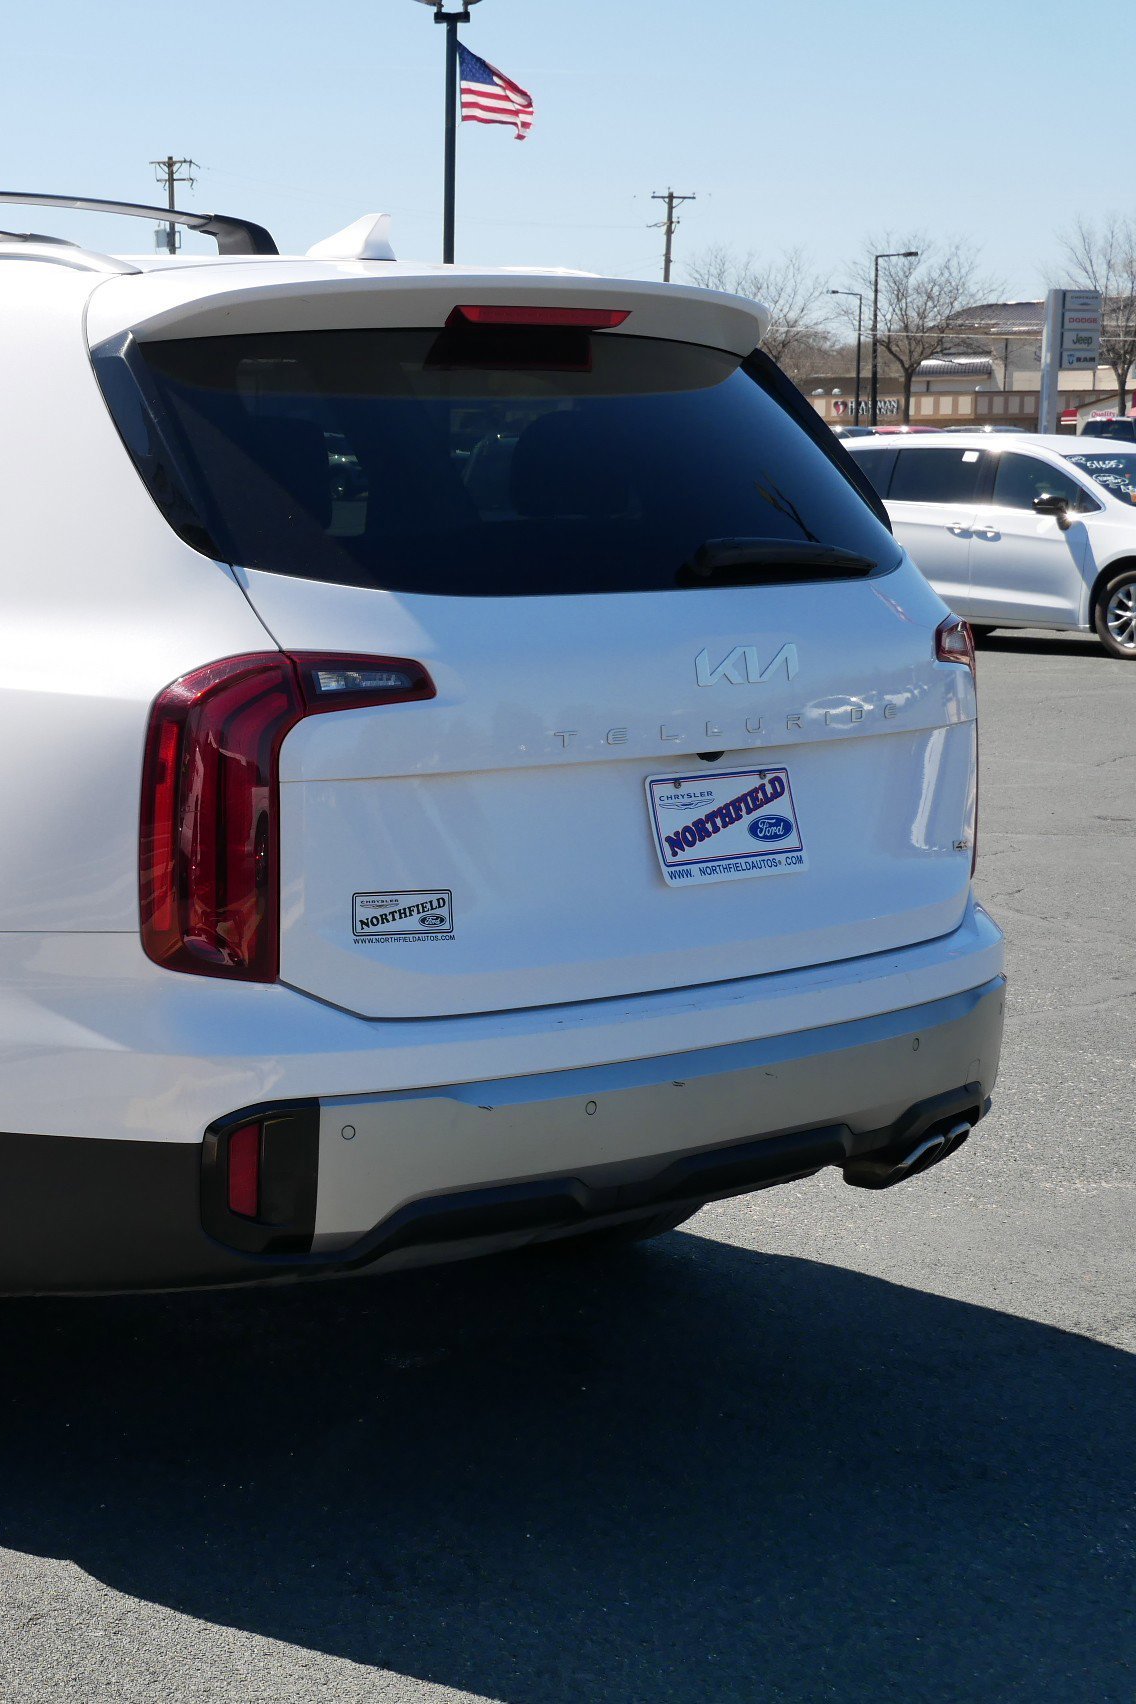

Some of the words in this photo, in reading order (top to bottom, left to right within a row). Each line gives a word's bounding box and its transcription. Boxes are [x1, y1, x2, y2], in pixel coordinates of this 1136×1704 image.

[1072, 333, 1093, 347] Jeep
[1091, 410, 1116, 418] Quality
[554, 703, 897, 748] TELLURIDE
[658, 790, 714, 802] CHRYSLER
[664, 775, 786, 858] NORTHFIELD
[757, 819, 785, 838] Ford
[358, 896, 447, 931] NORTHFIELD
[353, 934, 456, 945] WWW.NORTHFIELDAUTOS.COM
